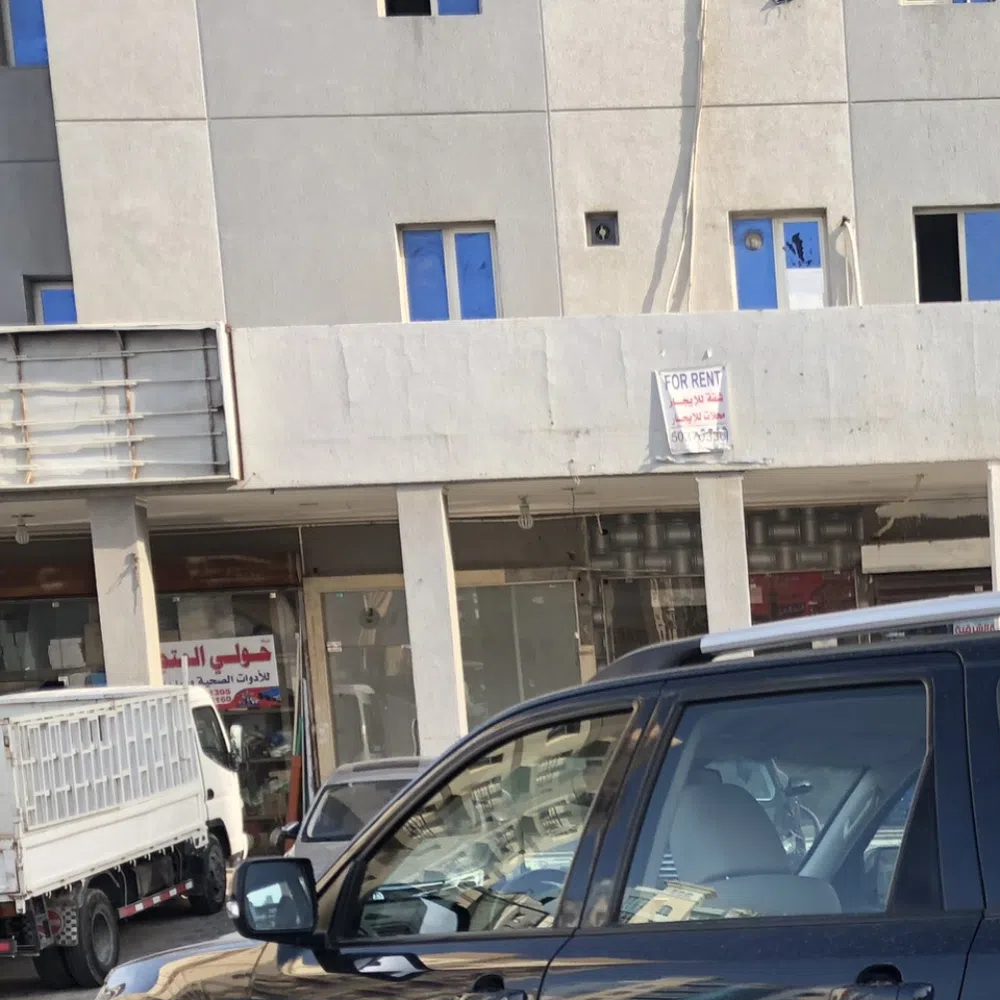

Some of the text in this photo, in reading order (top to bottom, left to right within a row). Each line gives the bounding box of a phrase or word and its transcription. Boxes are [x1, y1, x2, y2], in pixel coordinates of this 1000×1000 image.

[664, 371, 720, 390] FOR RENT
[210, 643, 272, 675] حولي
